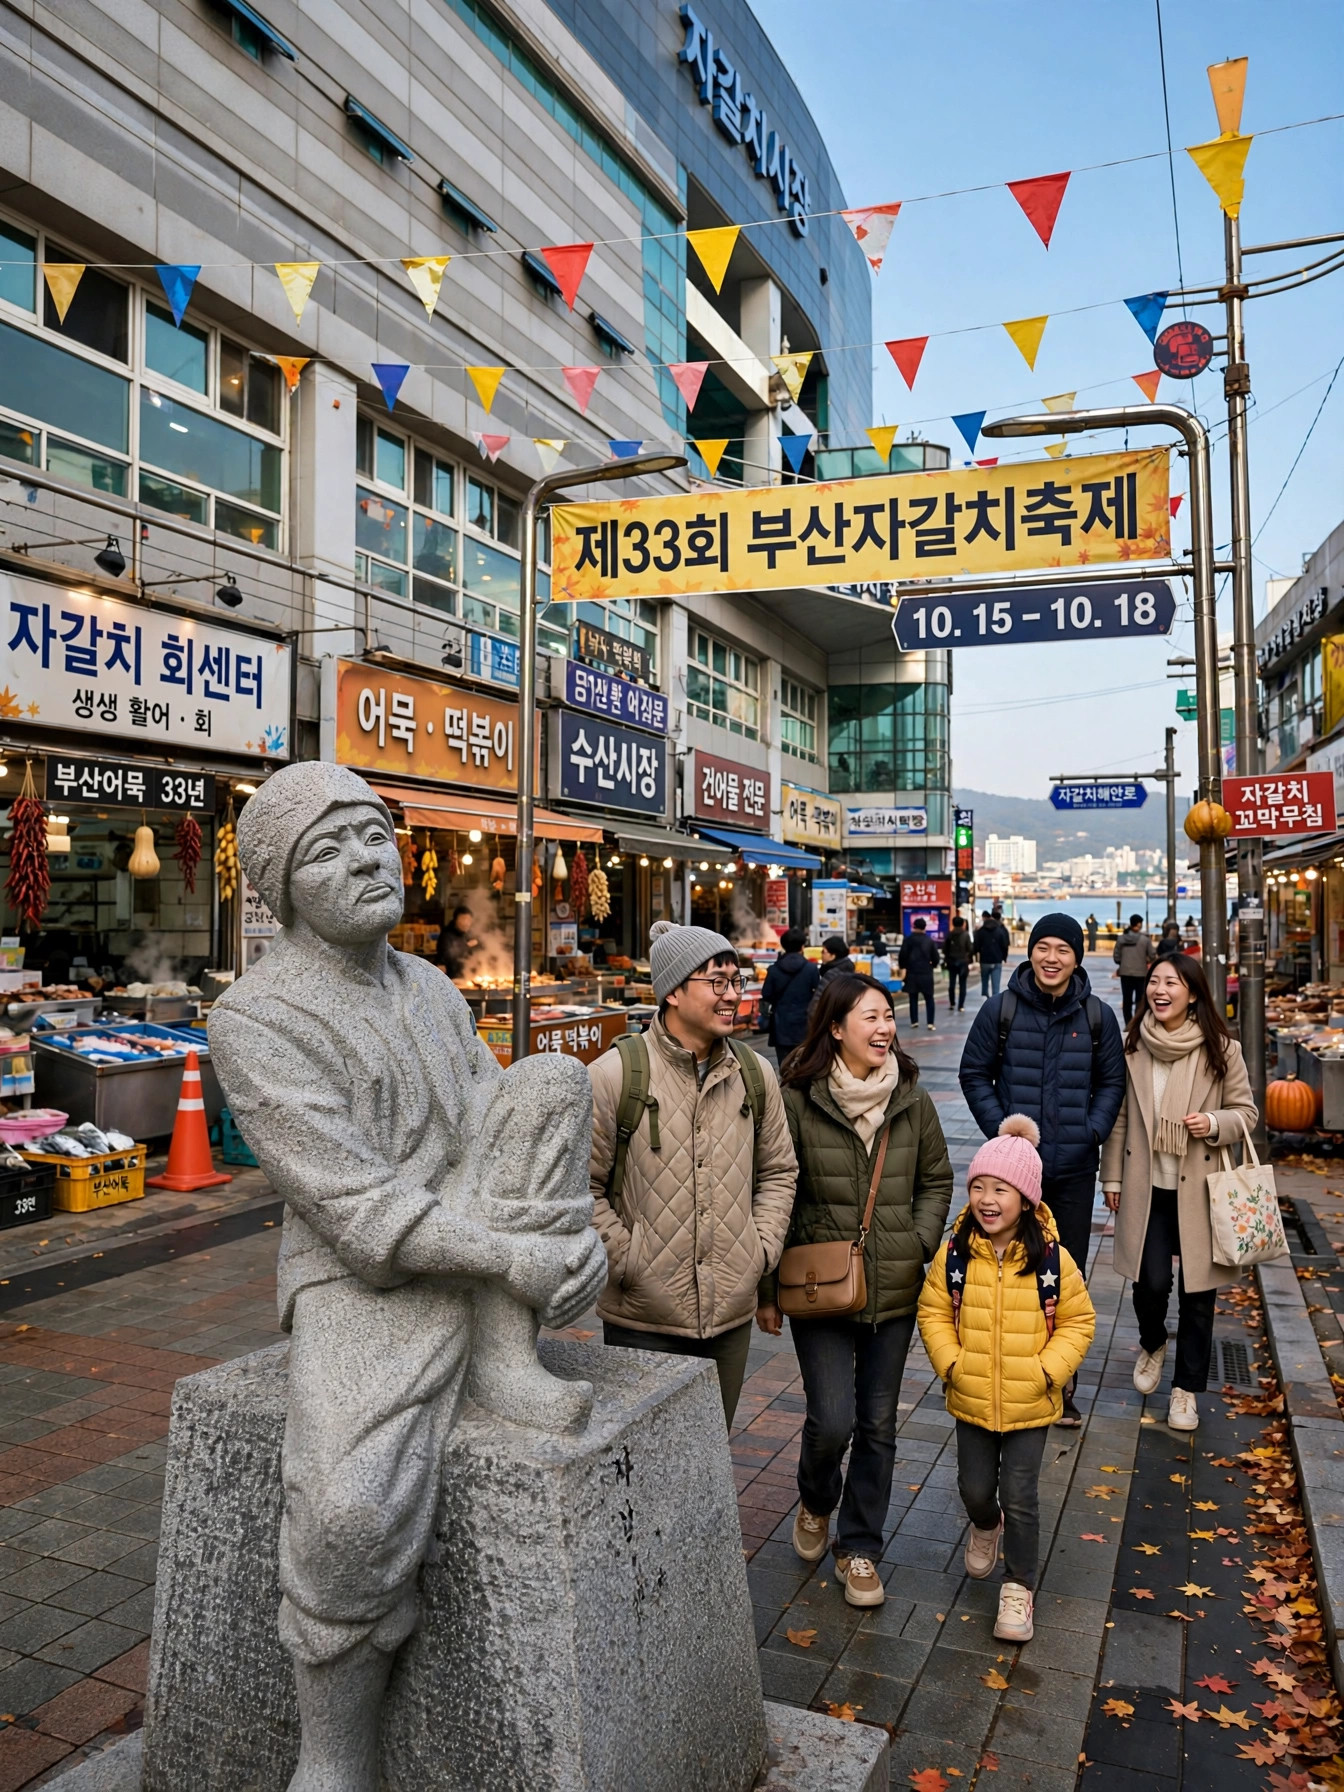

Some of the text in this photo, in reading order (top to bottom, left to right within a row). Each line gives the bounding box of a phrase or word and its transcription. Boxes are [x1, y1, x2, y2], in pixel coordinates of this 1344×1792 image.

[678, 3, 811, 238] 자갈치시장
[574, 472, 1138, 579] 제33회 부산자갈치축제
[912, 605, 961, 640] 10.
[972, 601, 1013, 635] 15
[1050, 595, 1102, 630] 10.
[1114, 591, 1157, 626] 18
[8, 601, 264, 710] 자갈치 회센터
[72, 688, 119, 723] 생생
[129, 696, 171, 732] 활어
[194, 708, 213, 738] 회
[357, 686, 418, 754] 어묵
[444, 706, 514, 772] 떡볶이
[54, 763, 206, 809] 부산어묵 33년
[569, 727, 659, 800] 수산시장
[702, 766, 766, 818] 건어물 전문
[1058, 786, 1138, 804] 자갈치해안로
[1235, 803, 1323, 831] 꼬막무침
[1240, 779, 1310, 806] 자갈치
